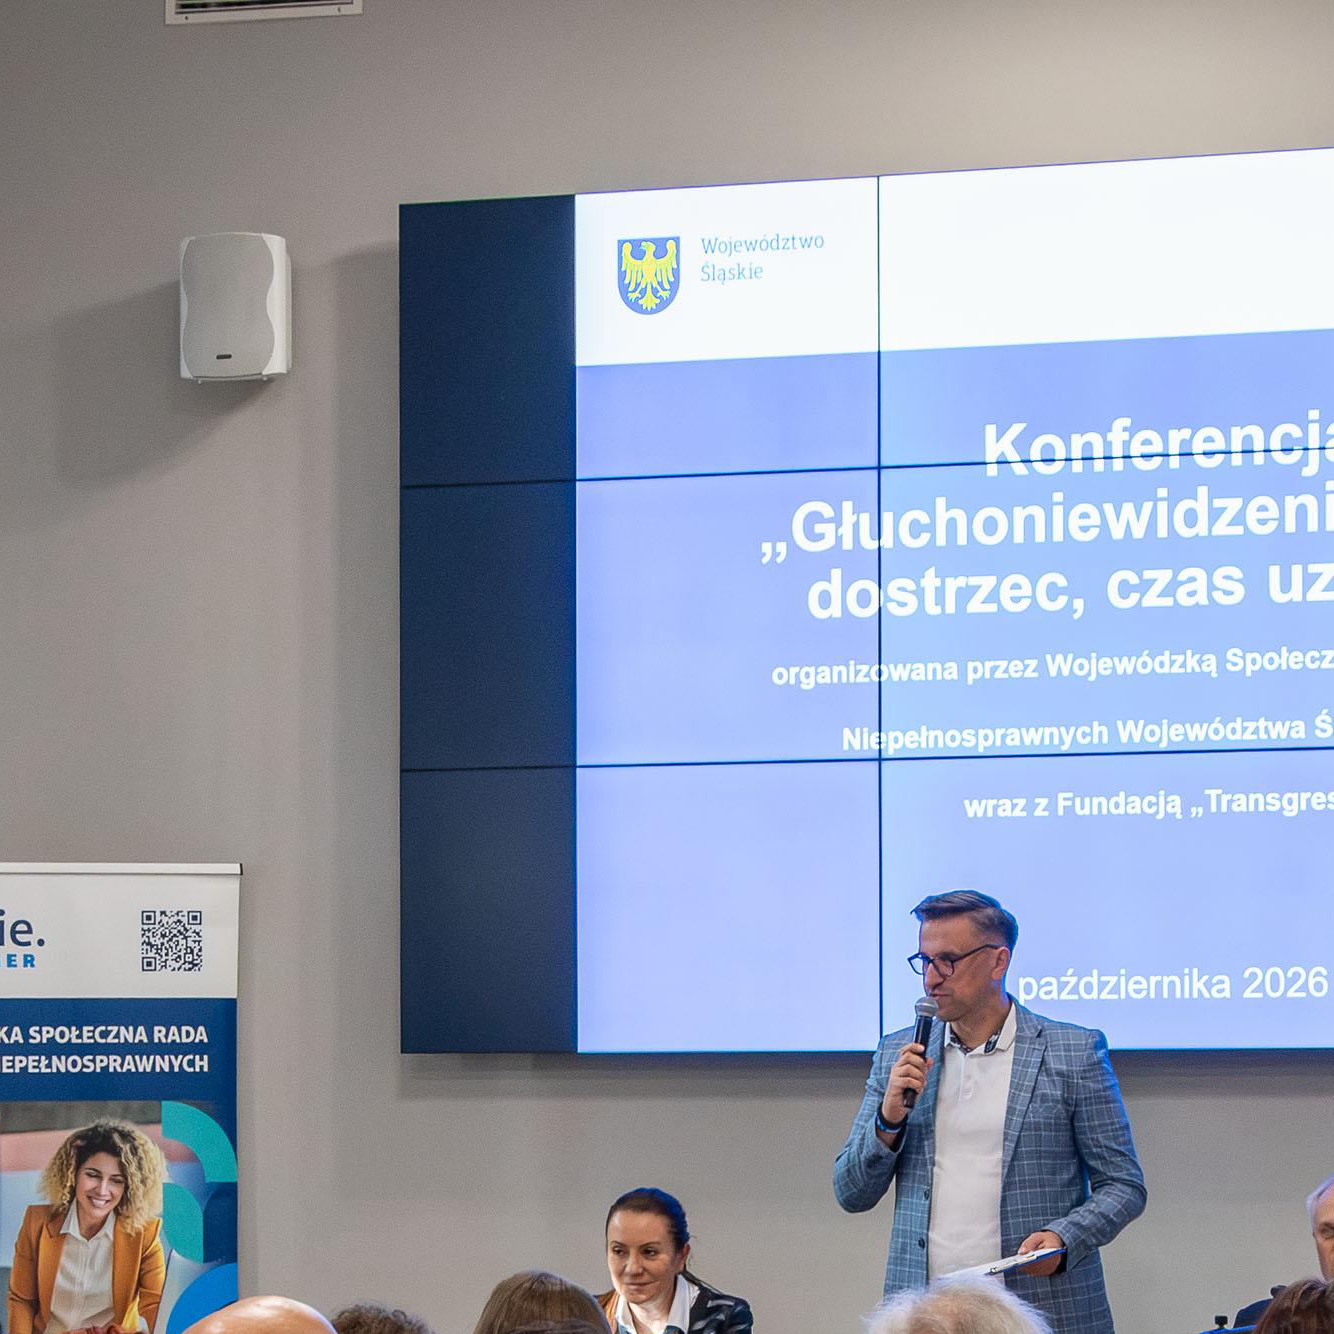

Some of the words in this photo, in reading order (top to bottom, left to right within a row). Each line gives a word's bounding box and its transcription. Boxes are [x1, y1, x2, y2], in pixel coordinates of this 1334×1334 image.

[701, 233, 825, 258] Województwo
[700, 261, 764, 285] Śląskie
[808, 567, 1084, 619] dostrzec,
[1108, 567, 1244, 608] czas
[772, 661, 958, 689] organizowana
[968, 660, 1038, 684] przez
[1046, 650, 1217, 681] Wojewódzką
[843, 721, 1108, 755] Niepełnosprawnych
[1117, 717, 1305, 748] Województwa
[964, 799, 1027, 817] wraz
[1034, 798, 1049, 816] z
[1058, 791, 1182, 819] Fundacją
[1018, 967, 1231, 1005] października
[1243, 967, 1328, 998] 2026
[29, 1025, 146, 1044] SPOŁECZNA
[154, 1025, 208, 1043] RADA
